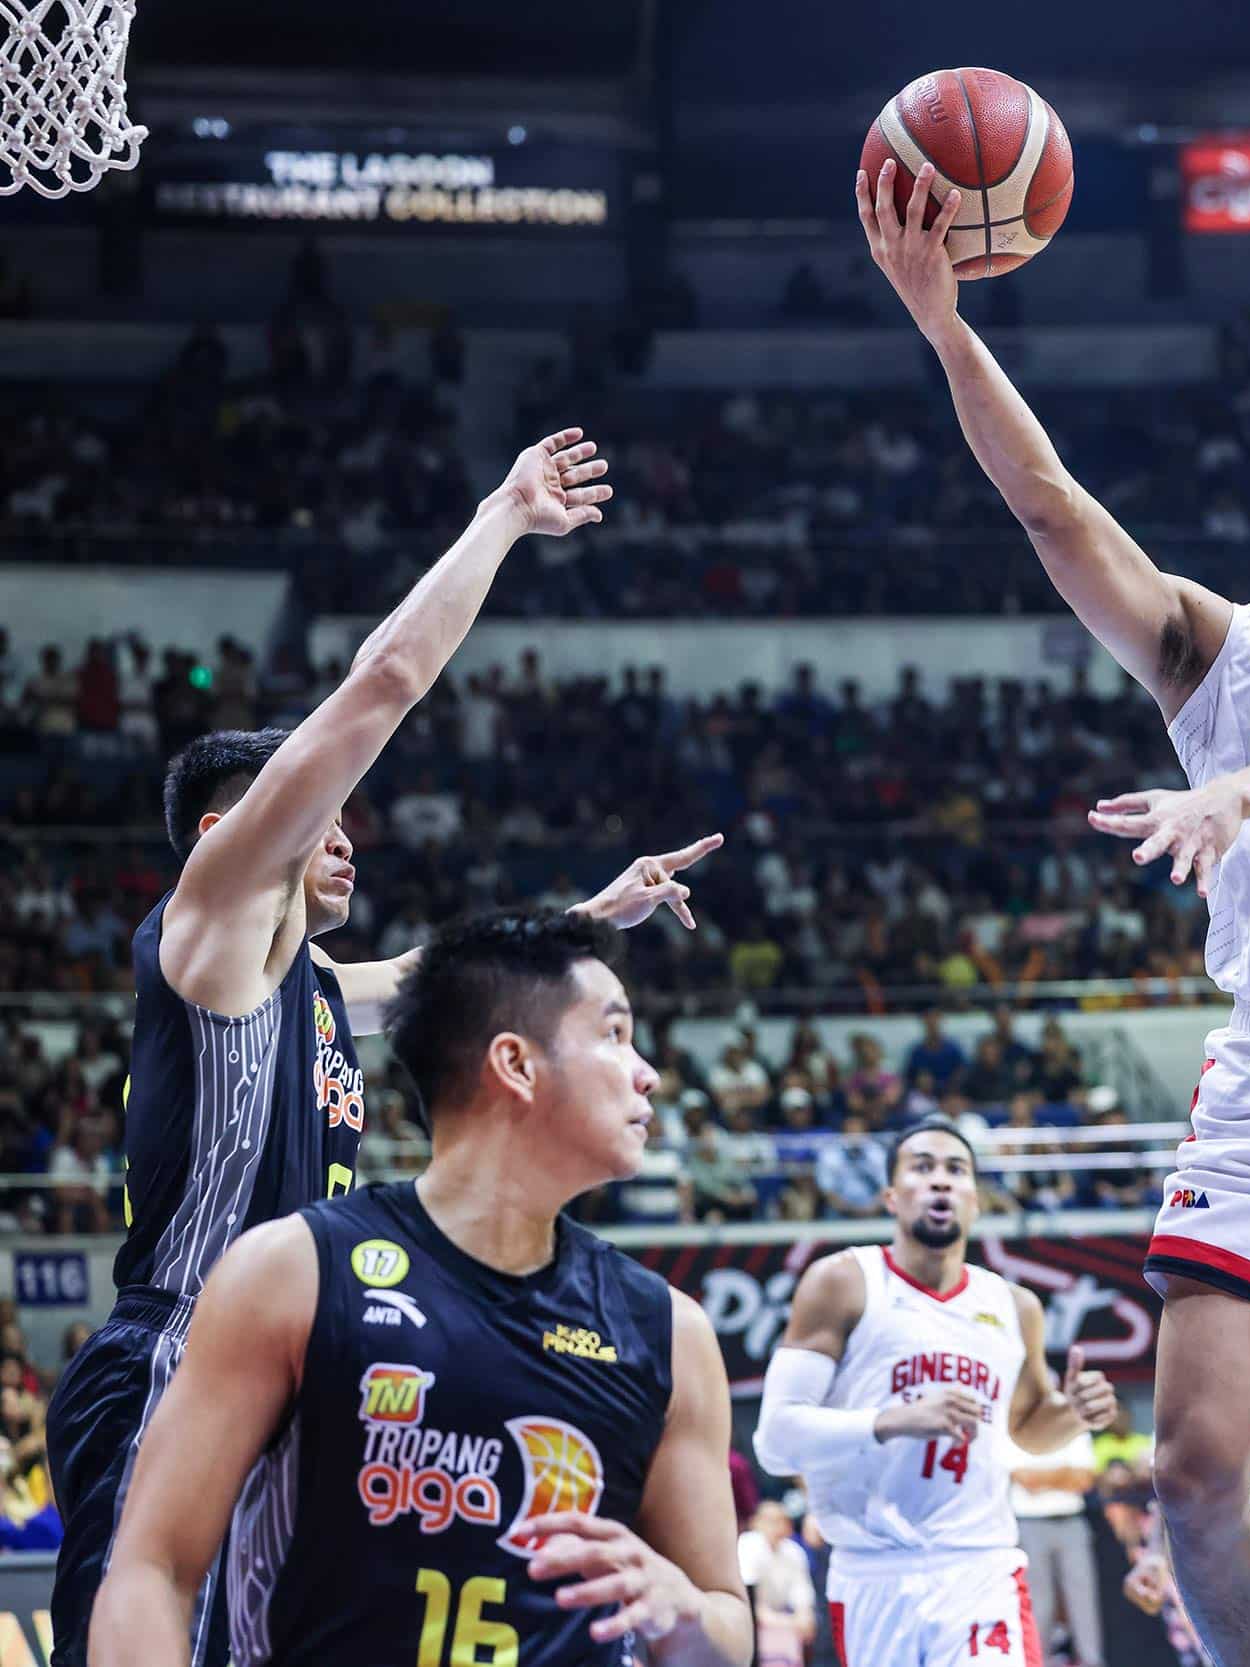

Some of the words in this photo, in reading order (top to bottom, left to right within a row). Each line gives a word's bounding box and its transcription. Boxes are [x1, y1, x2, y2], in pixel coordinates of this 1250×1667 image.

[1169, 1190, 1210, 1209] PBA
[22, 1260, 83, 1298] 116
[363, 1248, 400, 1277] 17
[362, 1305, 402, 1326] ANTA
[363, 1376, 429, 1416] TNT
[363, 1425, 504, 1478] TROPANG
[920, 1432, 970, 1485] 14
[358, 1462, 500, 1534] giga
[415, 1567, 520, 1667] 16
[969, 1619, 1011, 1658] 14
